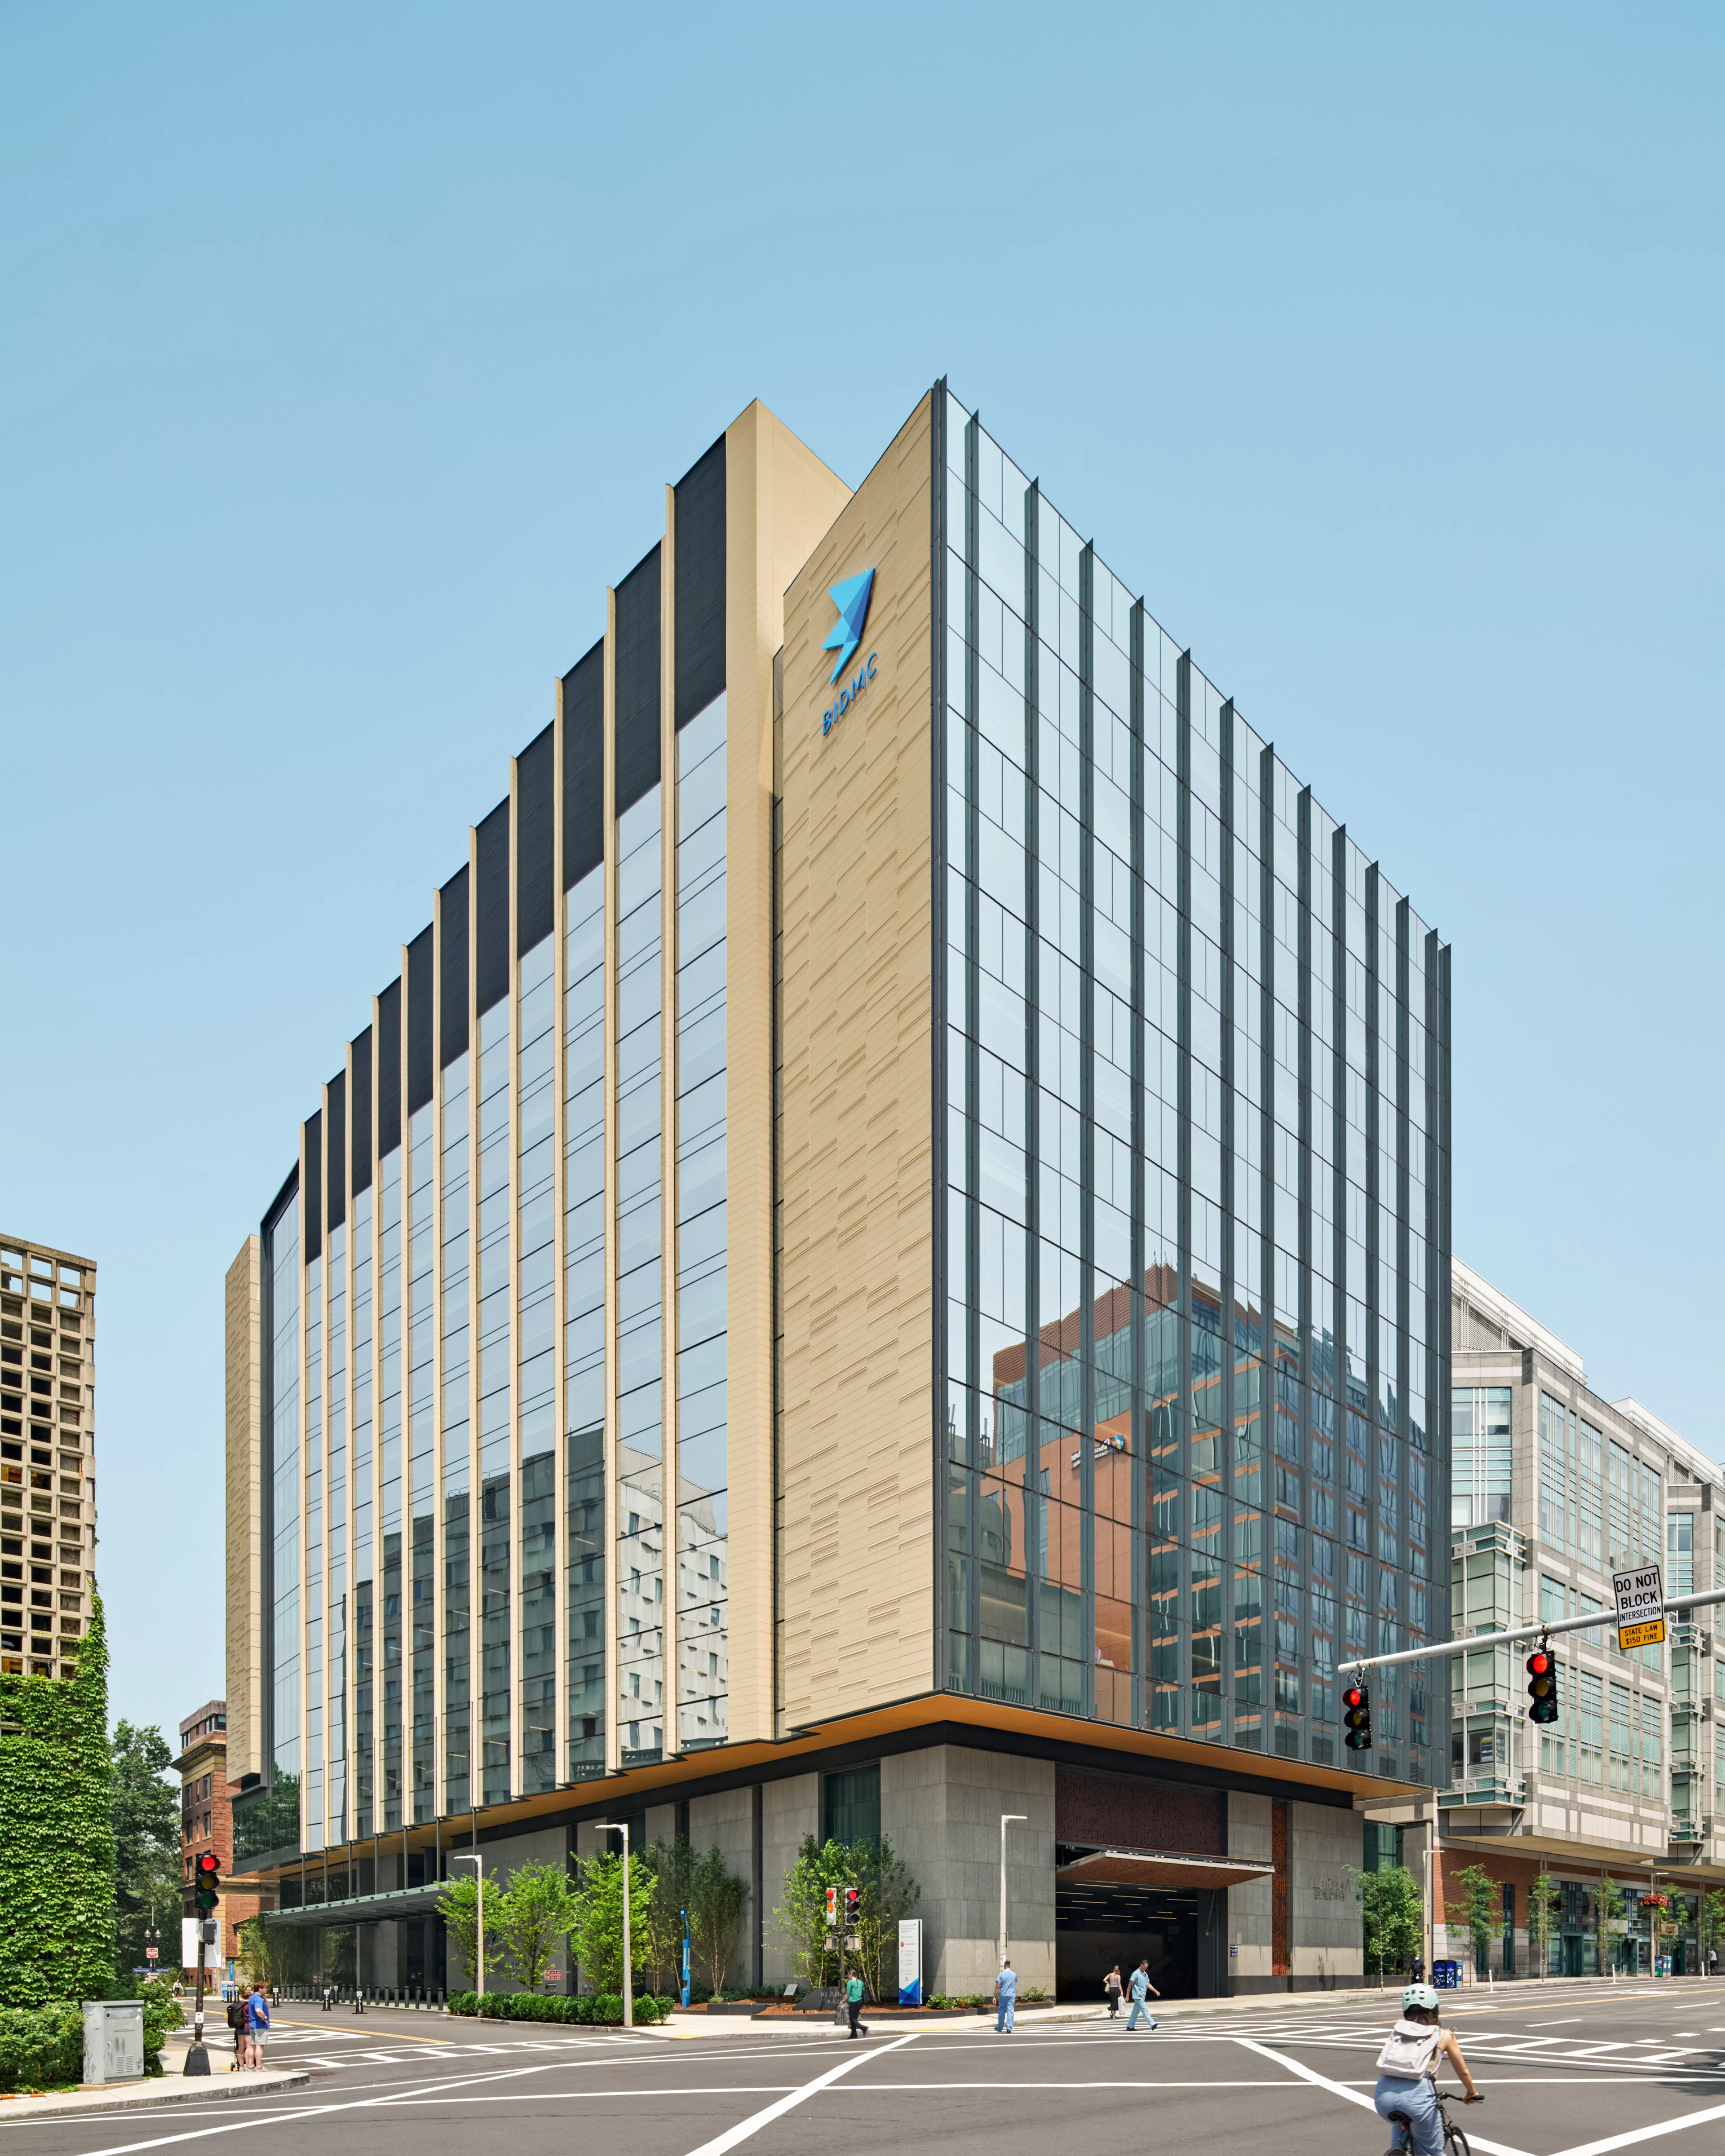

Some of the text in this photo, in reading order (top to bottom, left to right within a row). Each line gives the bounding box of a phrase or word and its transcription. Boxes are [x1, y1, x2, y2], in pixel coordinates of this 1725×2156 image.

[823, 652, 877, 736] BIDMC
[1616, 1573, 1657, 1592] DO NOT
[1621, 1590, 1658, 1609] BLOCK
[1619, 1606, 1661, 1621] INTERSECTION
[1624, 1624, 1658, 1636] STATE LAW
[1626, 1633, 1658, 1645] $150 FINE
[1314, 1891, 1345, 1902] BUILDING
